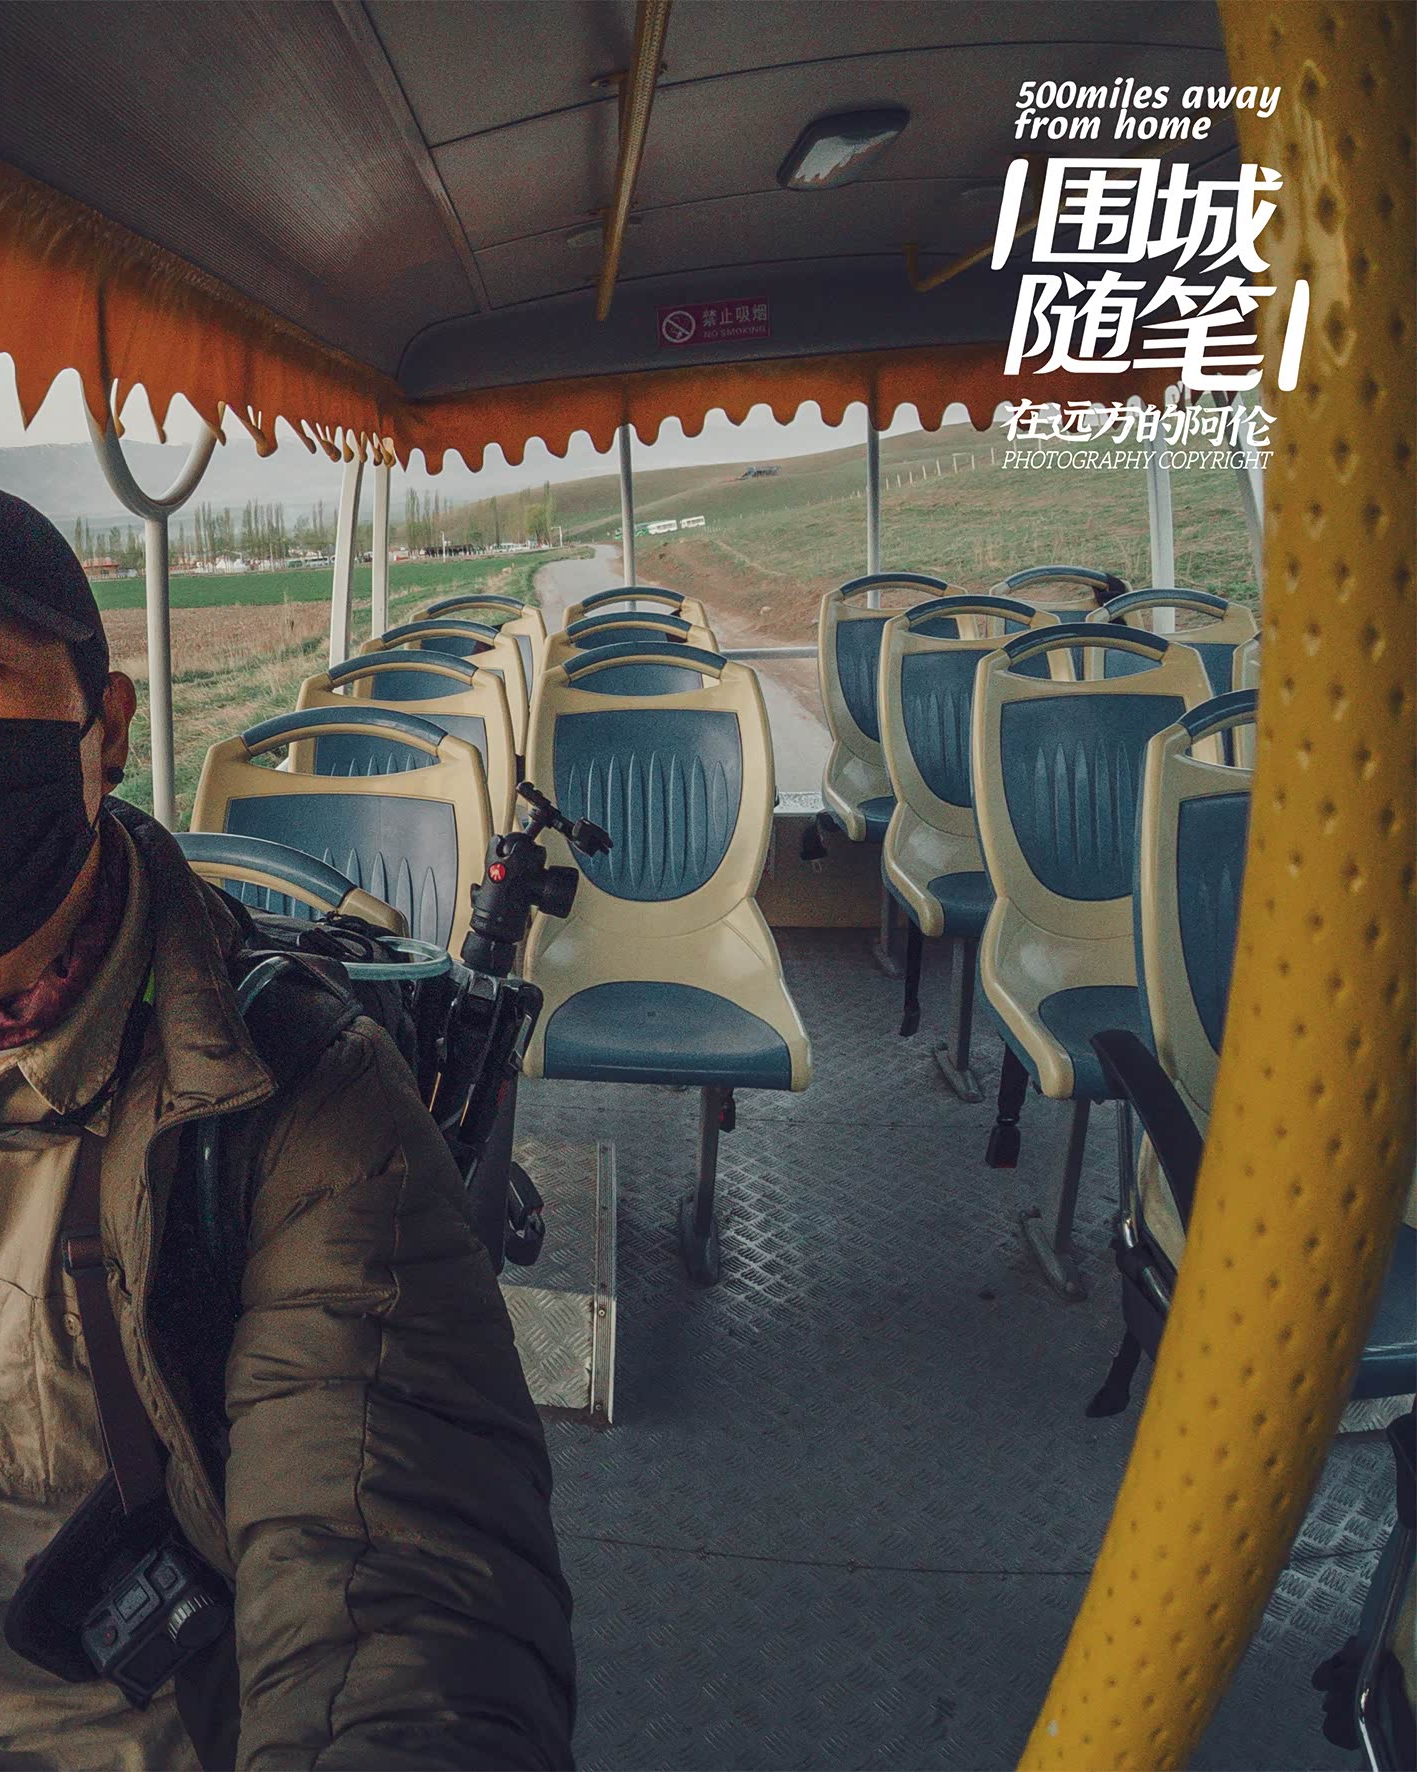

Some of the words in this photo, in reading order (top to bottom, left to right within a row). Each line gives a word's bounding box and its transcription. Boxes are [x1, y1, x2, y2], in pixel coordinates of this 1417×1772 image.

[703, 303, 768, 327] 禁止吸烟
[703, 330, 719, 338] NO
[720, 325, 767, 337] SMOKING
